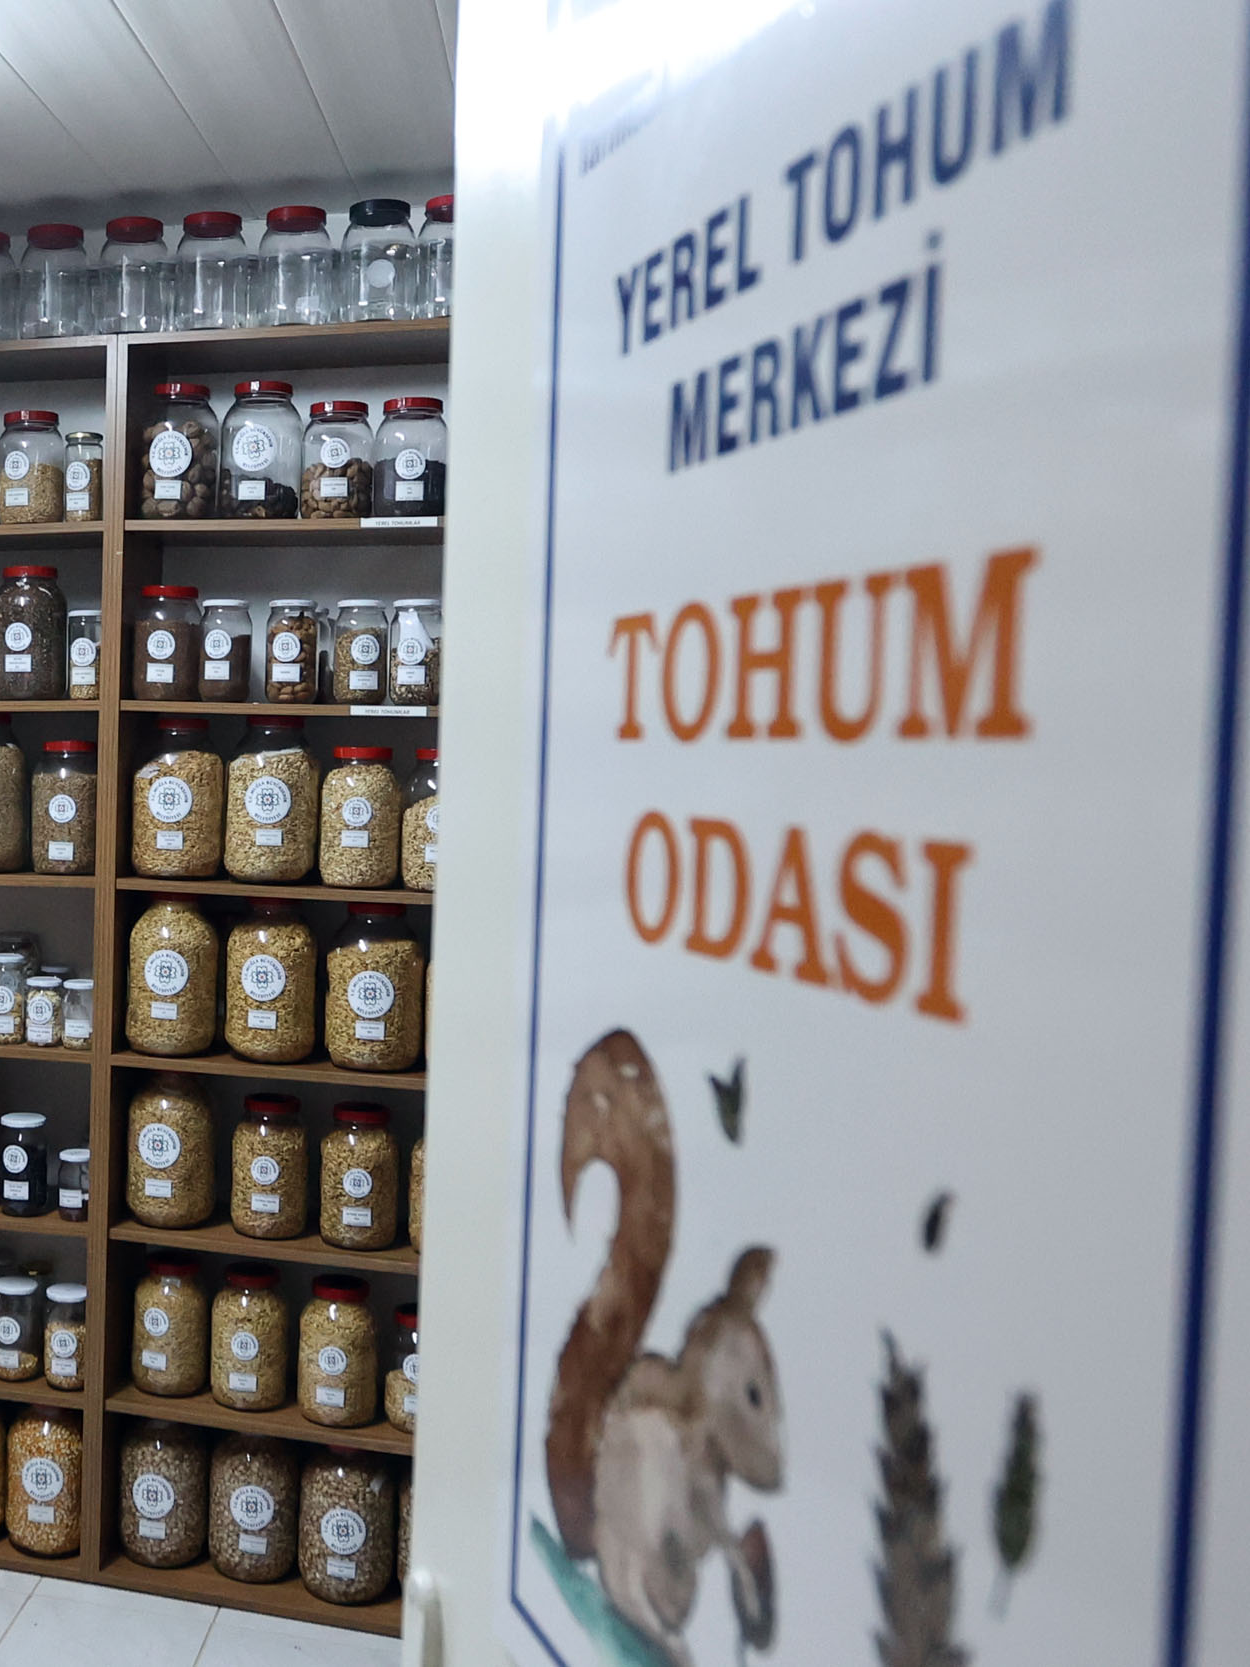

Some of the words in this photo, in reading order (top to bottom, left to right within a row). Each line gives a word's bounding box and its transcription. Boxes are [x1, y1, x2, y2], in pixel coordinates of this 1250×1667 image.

[615, 195, 760, 355] YEREL
[785, 0, 1071, 262] TOHUM
[667, 231, 942, 473] MERKEZİ
[610, 546, 1038, 742] TOHUM
[624, 810, 971, 1023] ODASI
